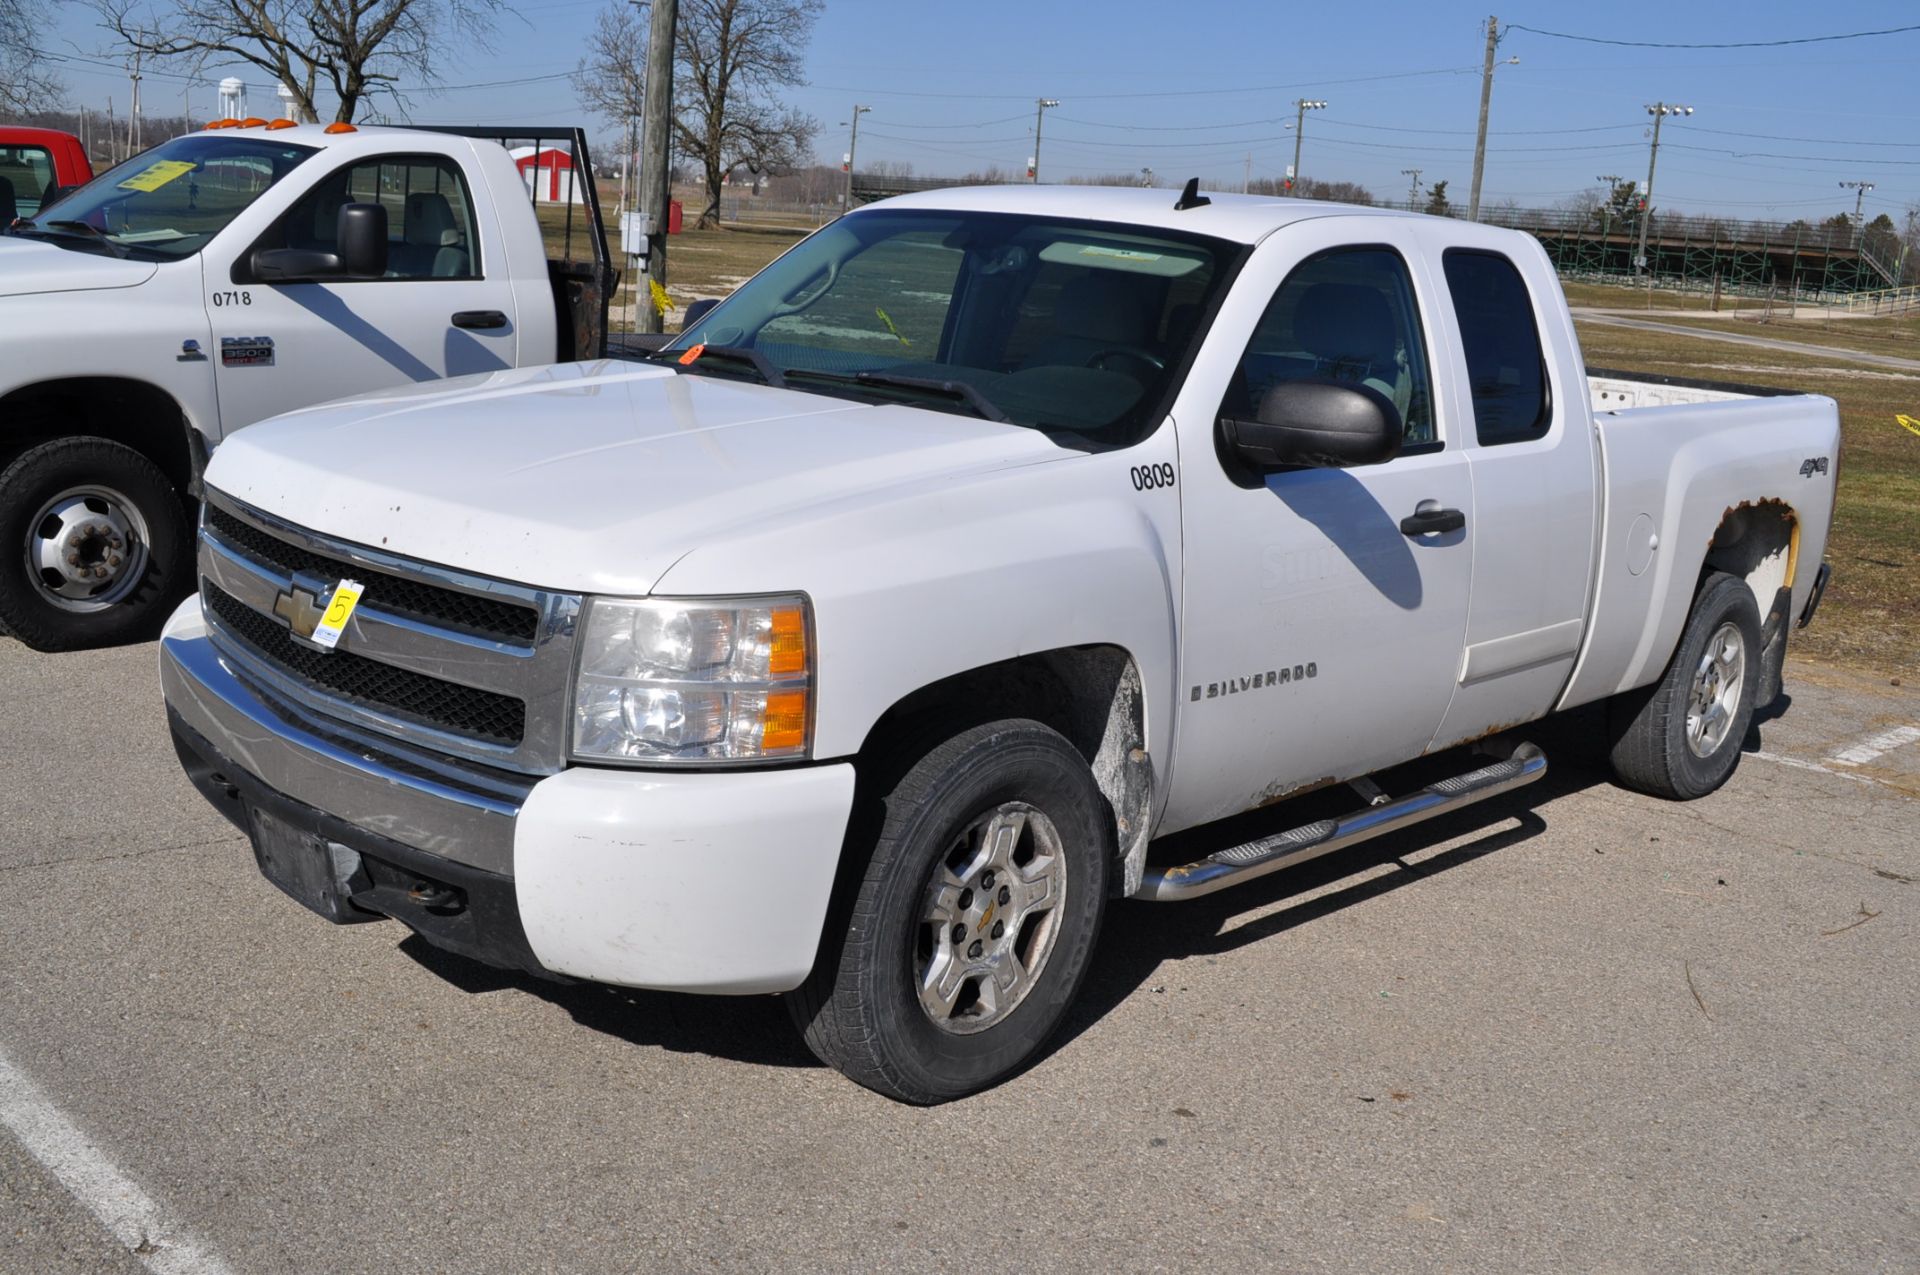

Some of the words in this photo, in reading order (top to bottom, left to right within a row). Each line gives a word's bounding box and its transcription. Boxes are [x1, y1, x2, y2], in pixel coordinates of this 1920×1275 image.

[212, 290, 252, 308] 0718
[1130, 462, 1175, 492] 0809
[328, 595, 351, 623] 5
[1206, 661, 1318, 699] SILVERADO
